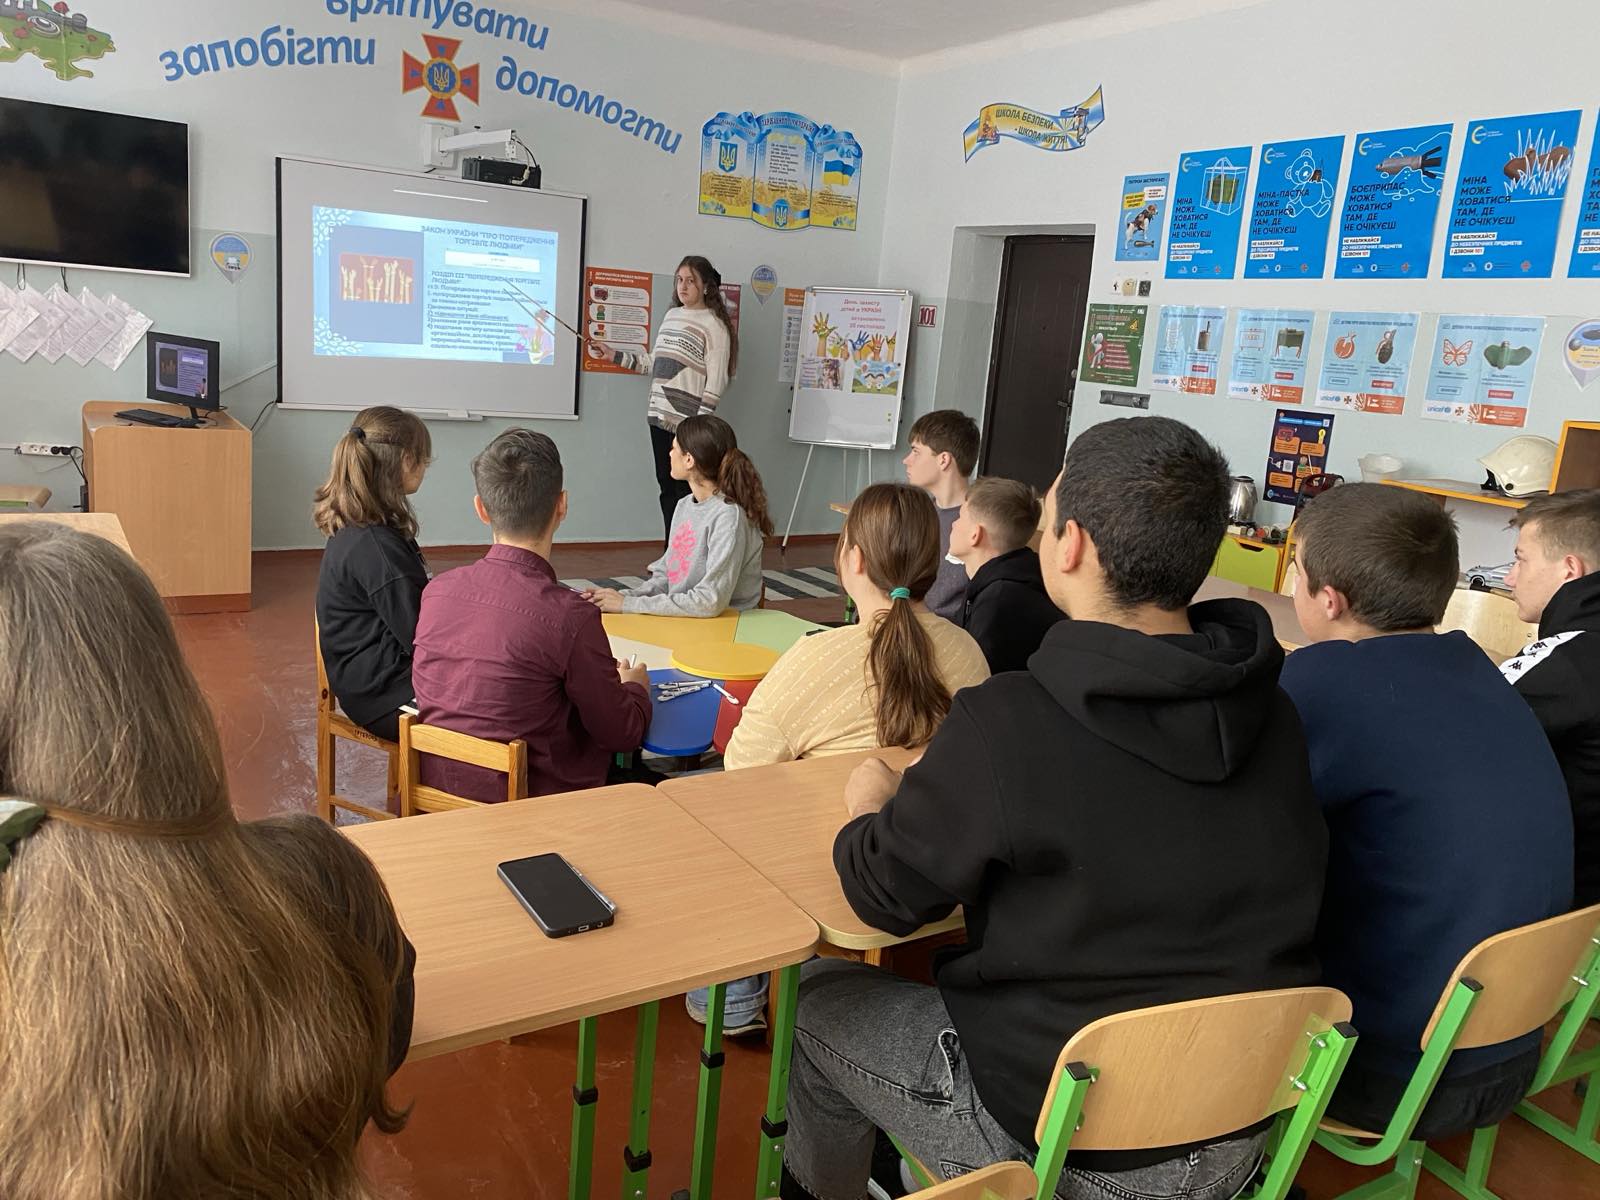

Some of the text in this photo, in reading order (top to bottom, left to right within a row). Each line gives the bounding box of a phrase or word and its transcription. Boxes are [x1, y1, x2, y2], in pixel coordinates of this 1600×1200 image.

[159, 25, 376, 82] запобігти
[495, 56, 683, 154] допомогти
[996, 109, 1054, 130] ШКОЛА БЕЗПЕКИ
[1018, 126, 1042, 140] ШКОЛА
[1462, 175, 1487, 185] МІНА
[1351, 182, 1405, 193] БОЄПРИПАС
[1461, 186, 1492, 196] МОЖЕ
[1258, 189, 1310, 198] МІНА-ПАСТКА
[1350, 194, 1375, 202] МОЖЕ
[1257, 200, 1280, 208] МОЖЕ
[1458, 196, 1512, 206] ХОВАТИСЯ
[1256, 208, 1294, 216] ХОВАТИСЯ
[1347, 203, 1392, 212] ХОВАТИСЯ
[1457, 207, 1495, 216] ТАМ, ДЕ
[1174, 214, 1208, 222] ХОВАТИСЯ
[1366, 213, 1378, 221] ДЕ
[1454, 216, 1516, 227] НЕ ОЧІКУЄШ
[1584, 213, 1598, 222] НЕ
[1344, 222, 1396, 231] НЕ ОЧІКУЄШ
[919, 306, 936, 326] 101
